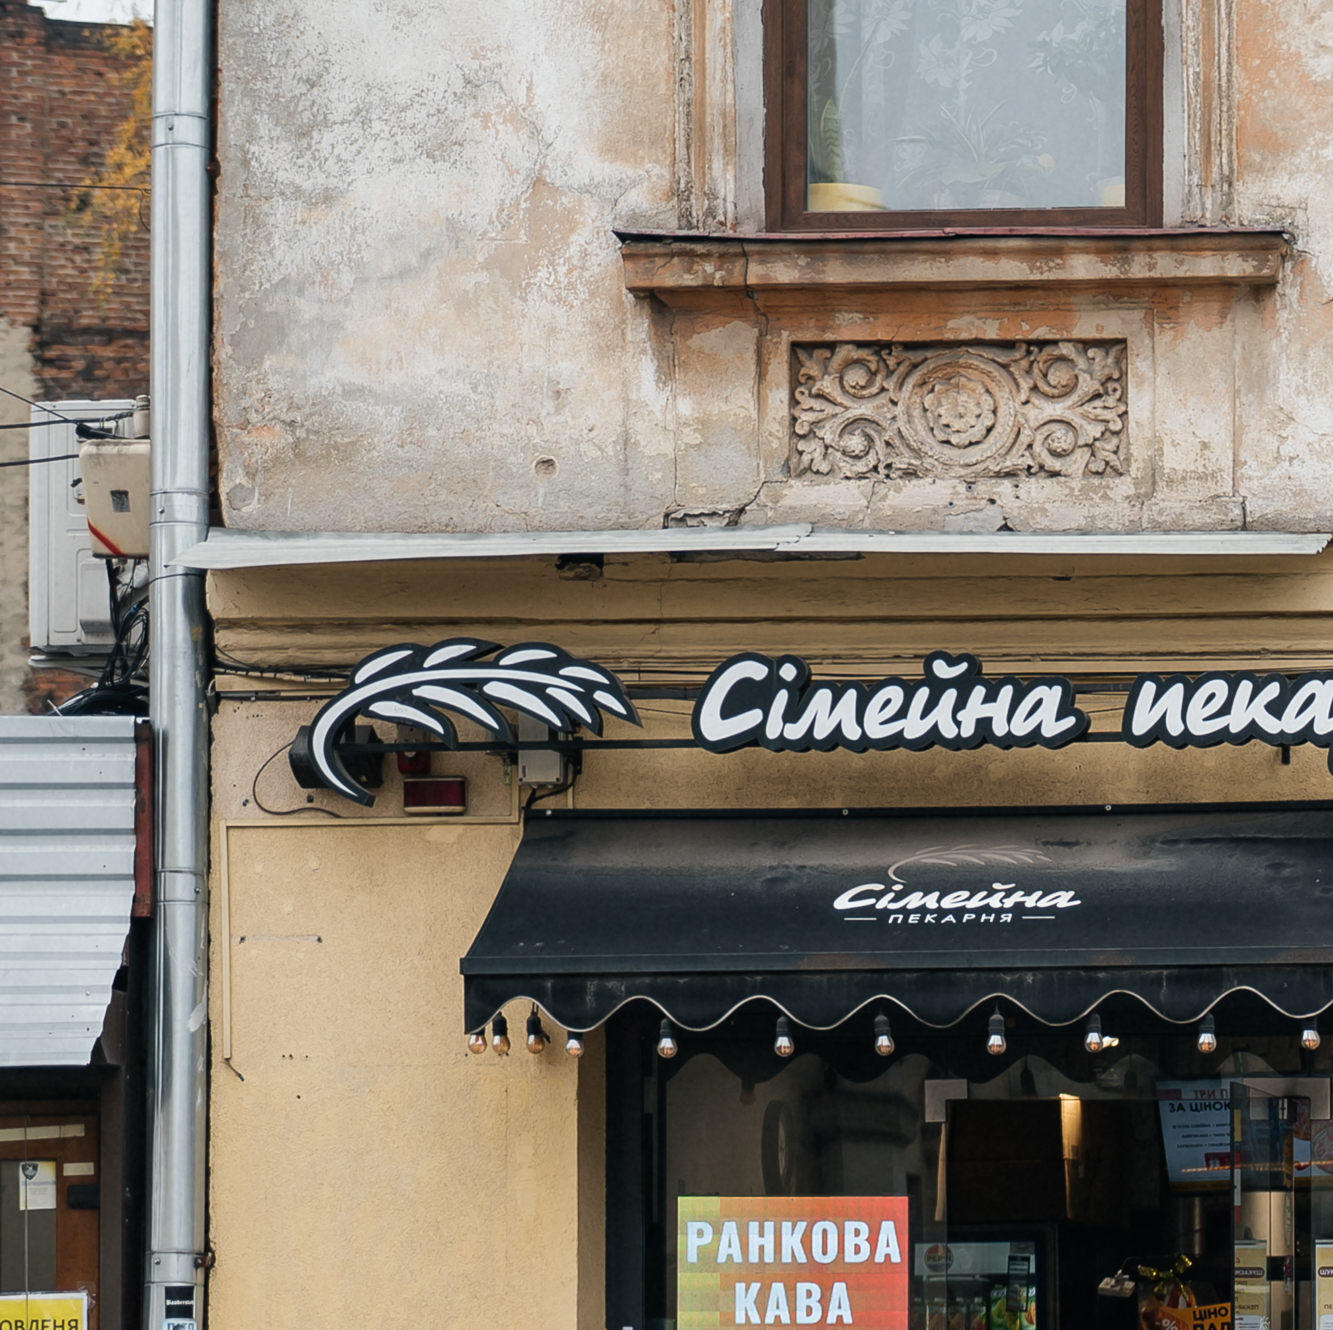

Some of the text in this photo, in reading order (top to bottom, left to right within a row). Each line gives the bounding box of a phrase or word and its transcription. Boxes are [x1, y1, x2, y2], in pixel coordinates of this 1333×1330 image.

[699, 659, 1076, 741] Сімейна
[833, 882, 1081, 910] Сімейна
[888, 913, 1013, 924] ПЕКАРНЯ
[1168, 1102, 1186, 1113] ЗА
[686, 1221, 901, 1263] РАНКОВА
[735, 1282, 853, 1324] КАВА
[1192, 1306, 1229, 1322] ЦІНО
